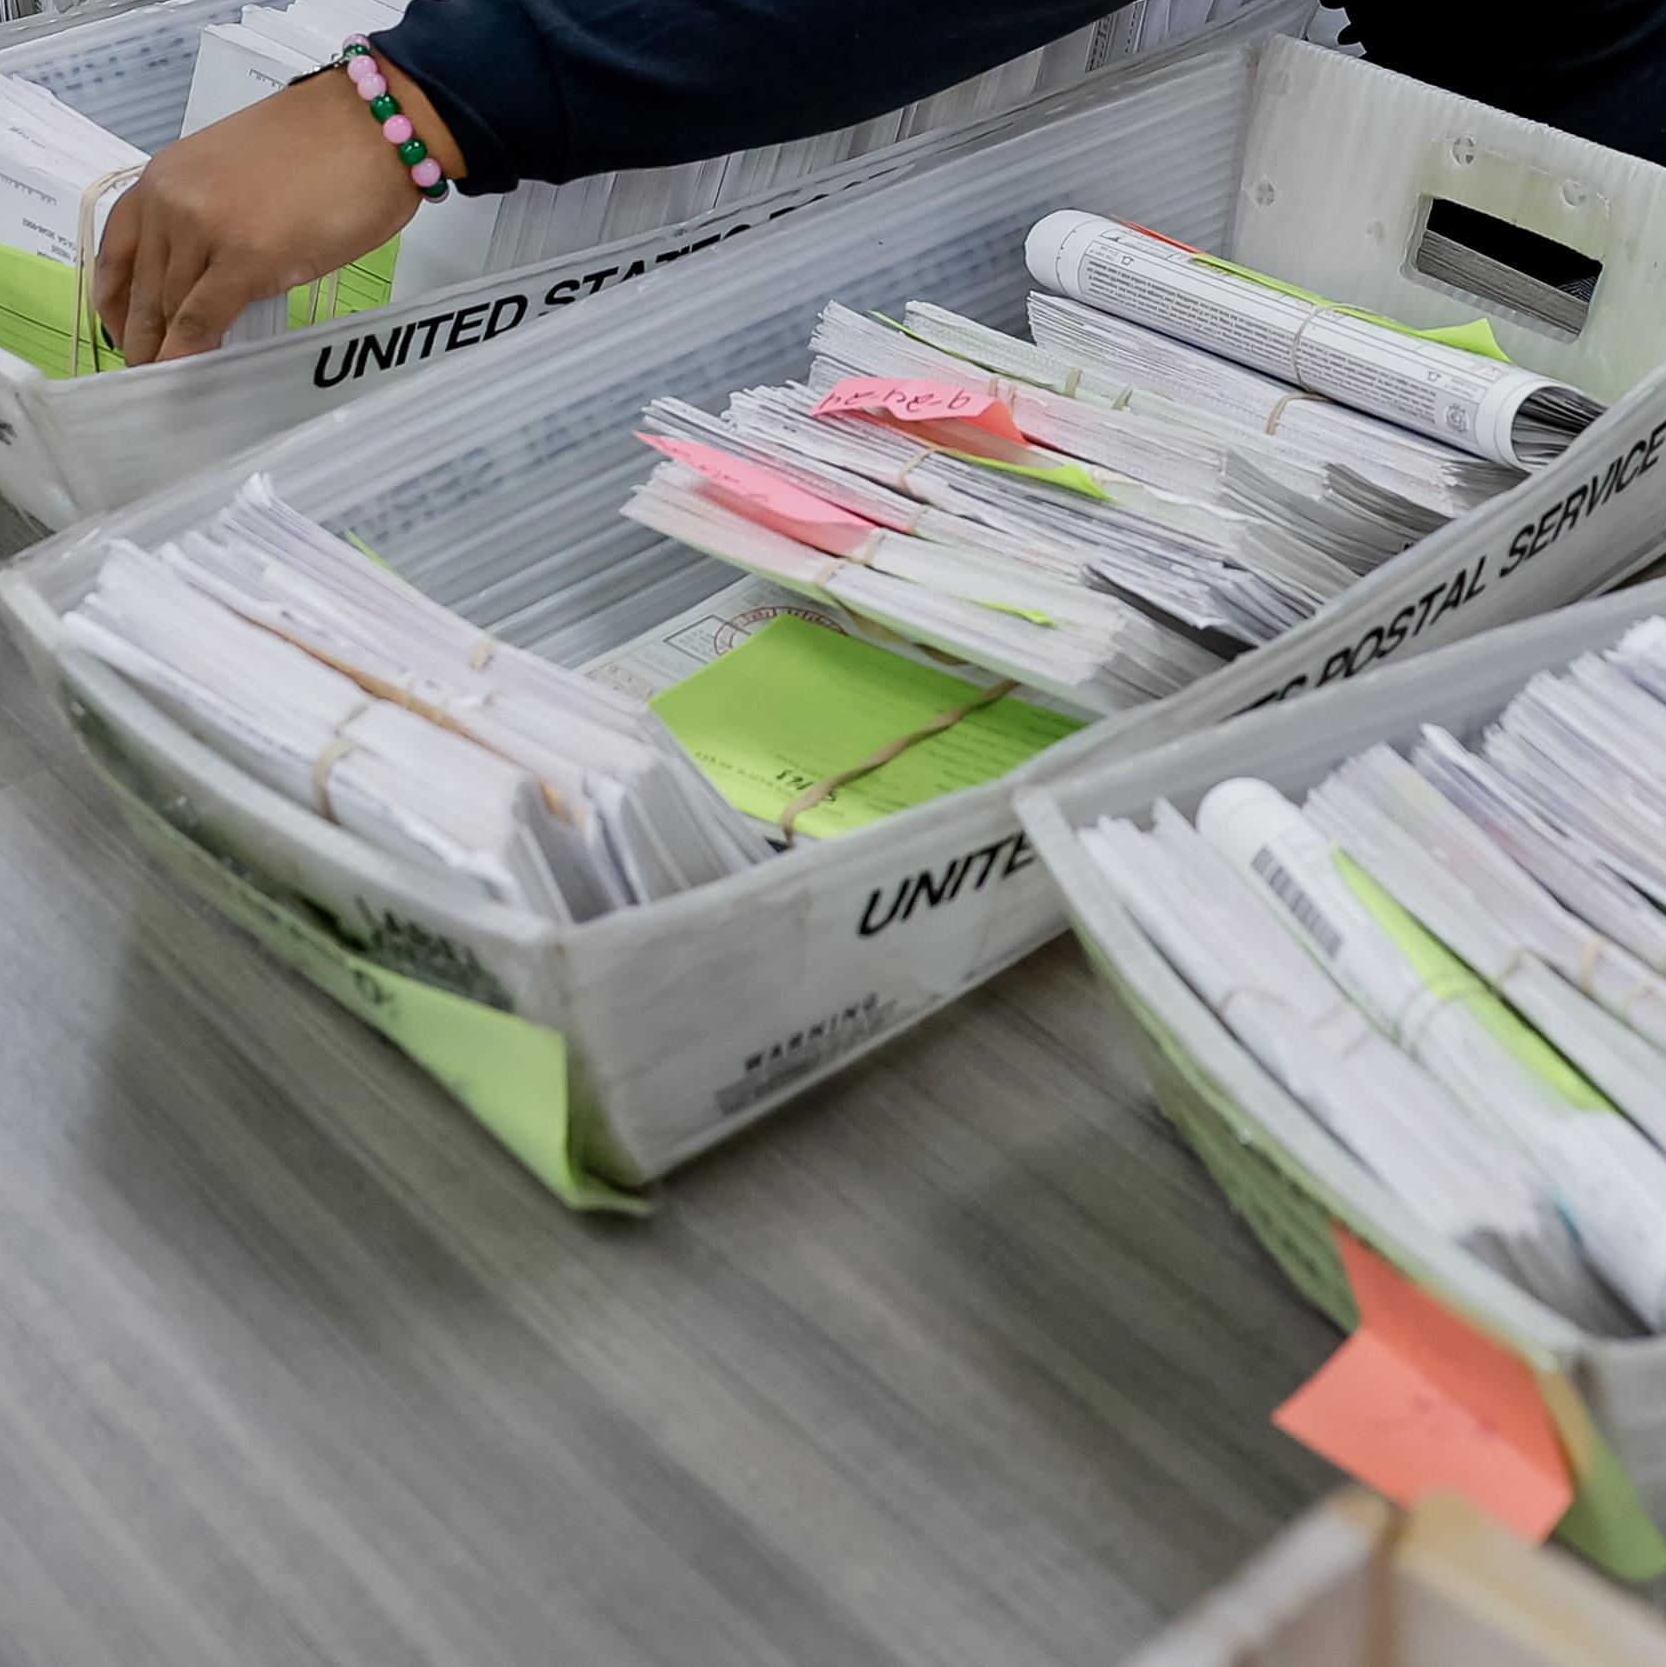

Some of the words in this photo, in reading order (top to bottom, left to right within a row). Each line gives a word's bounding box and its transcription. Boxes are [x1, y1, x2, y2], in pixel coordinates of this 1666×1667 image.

[312, 293, 528, 389] UNITED
[859, 830, 1037, 936] UNITE
[1322, 555, 1487, 683] POSTAL
